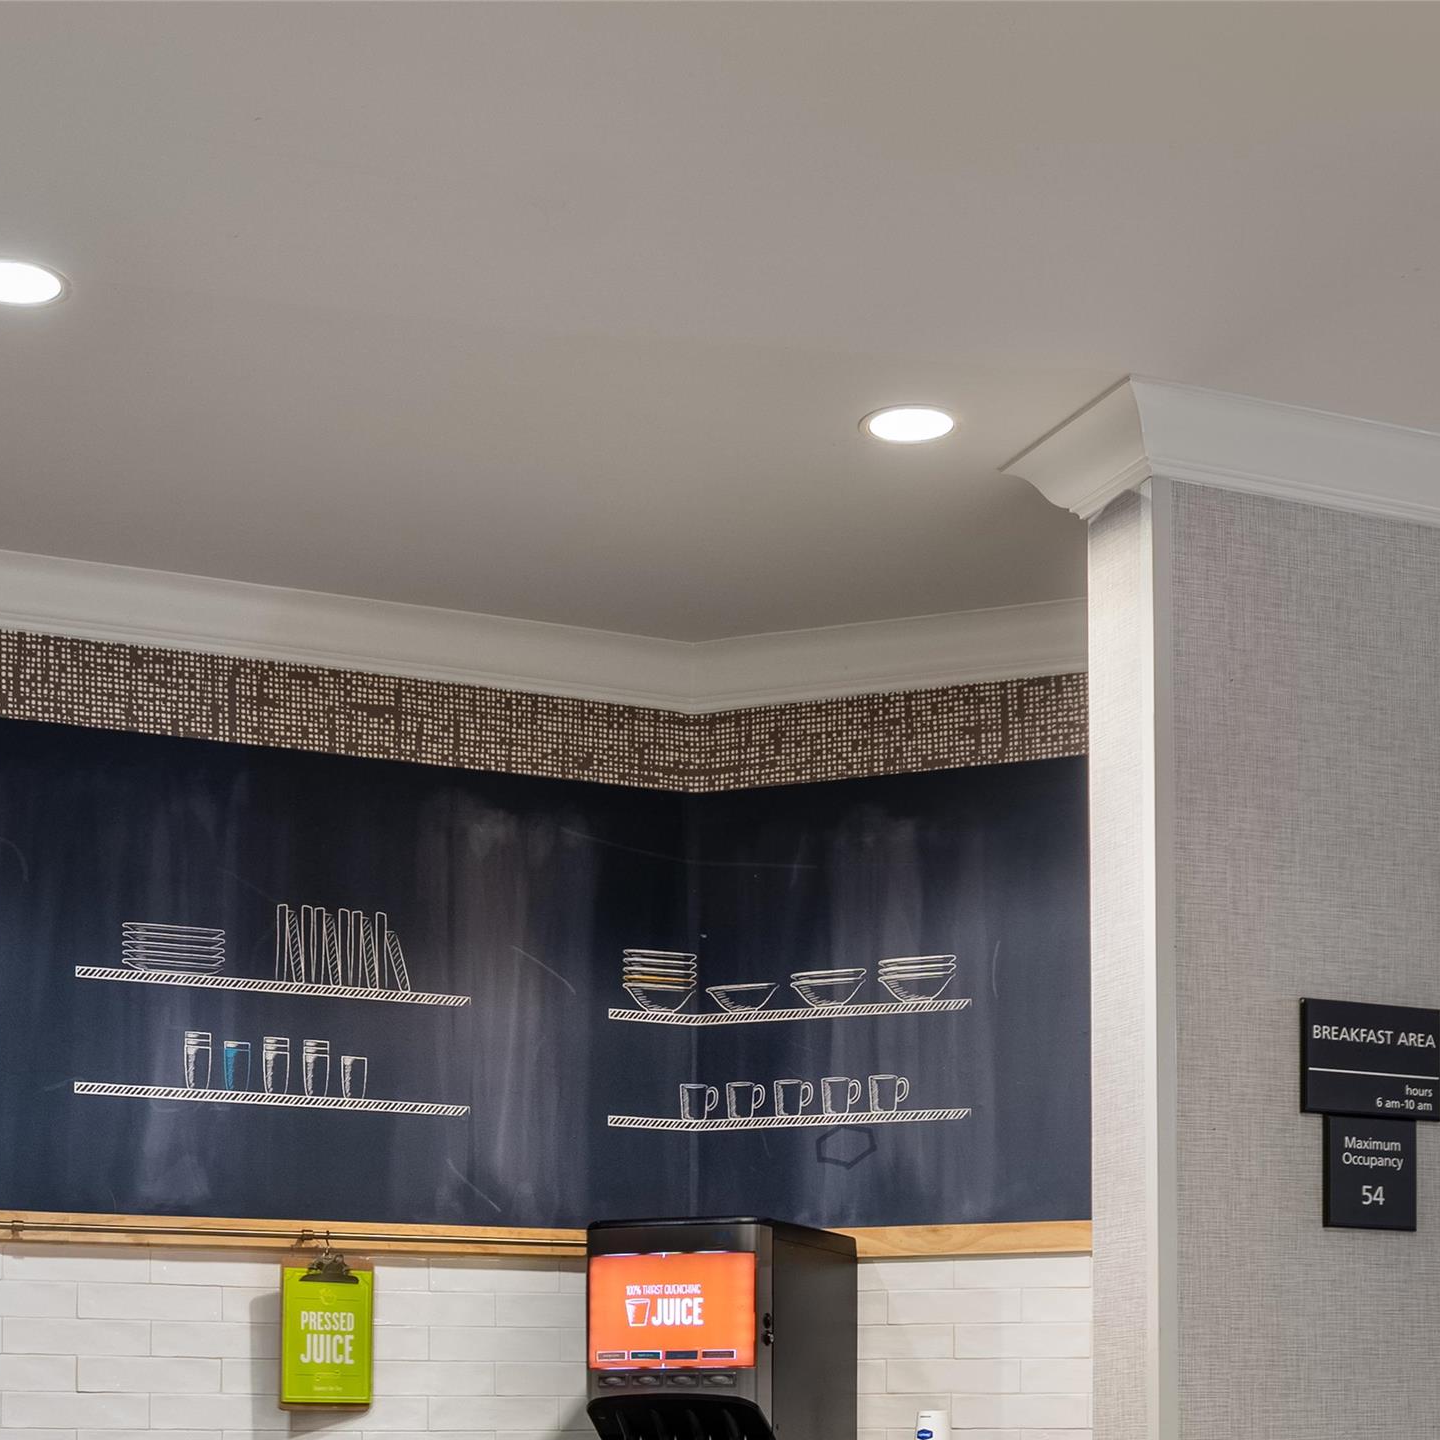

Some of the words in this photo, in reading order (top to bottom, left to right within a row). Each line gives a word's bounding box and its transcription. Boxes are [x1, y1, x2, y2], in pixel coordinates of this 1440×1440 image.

[1313, 1024, 1394, 1045] BREAKFAST
[1397, 1032, 1437, 1049] AREA
[1405, 1084, 1433, 1098] hours
[1376, 1098, 1383, 1108] 6
[1385, 1099, 1415, 1110] am-10
[1417, 1102, 1433, 1112] am
[1344, 1136, 1401, 1152] Maximum
[1341, 1152, 1404, 1172] Occupancy
[1361, 1184, 1385, 1206] 54
[626, 1285, 641, 1296] 100%
[643, 1284, 663, 1295] THIRST
[664, 1283, 701, 1295] QUENCHING
[301, 1311, 355, 1332] PRESSED
[651, 1297, 705, 1326] JUICE
[300, 1334, 355, 1364] JUICE
